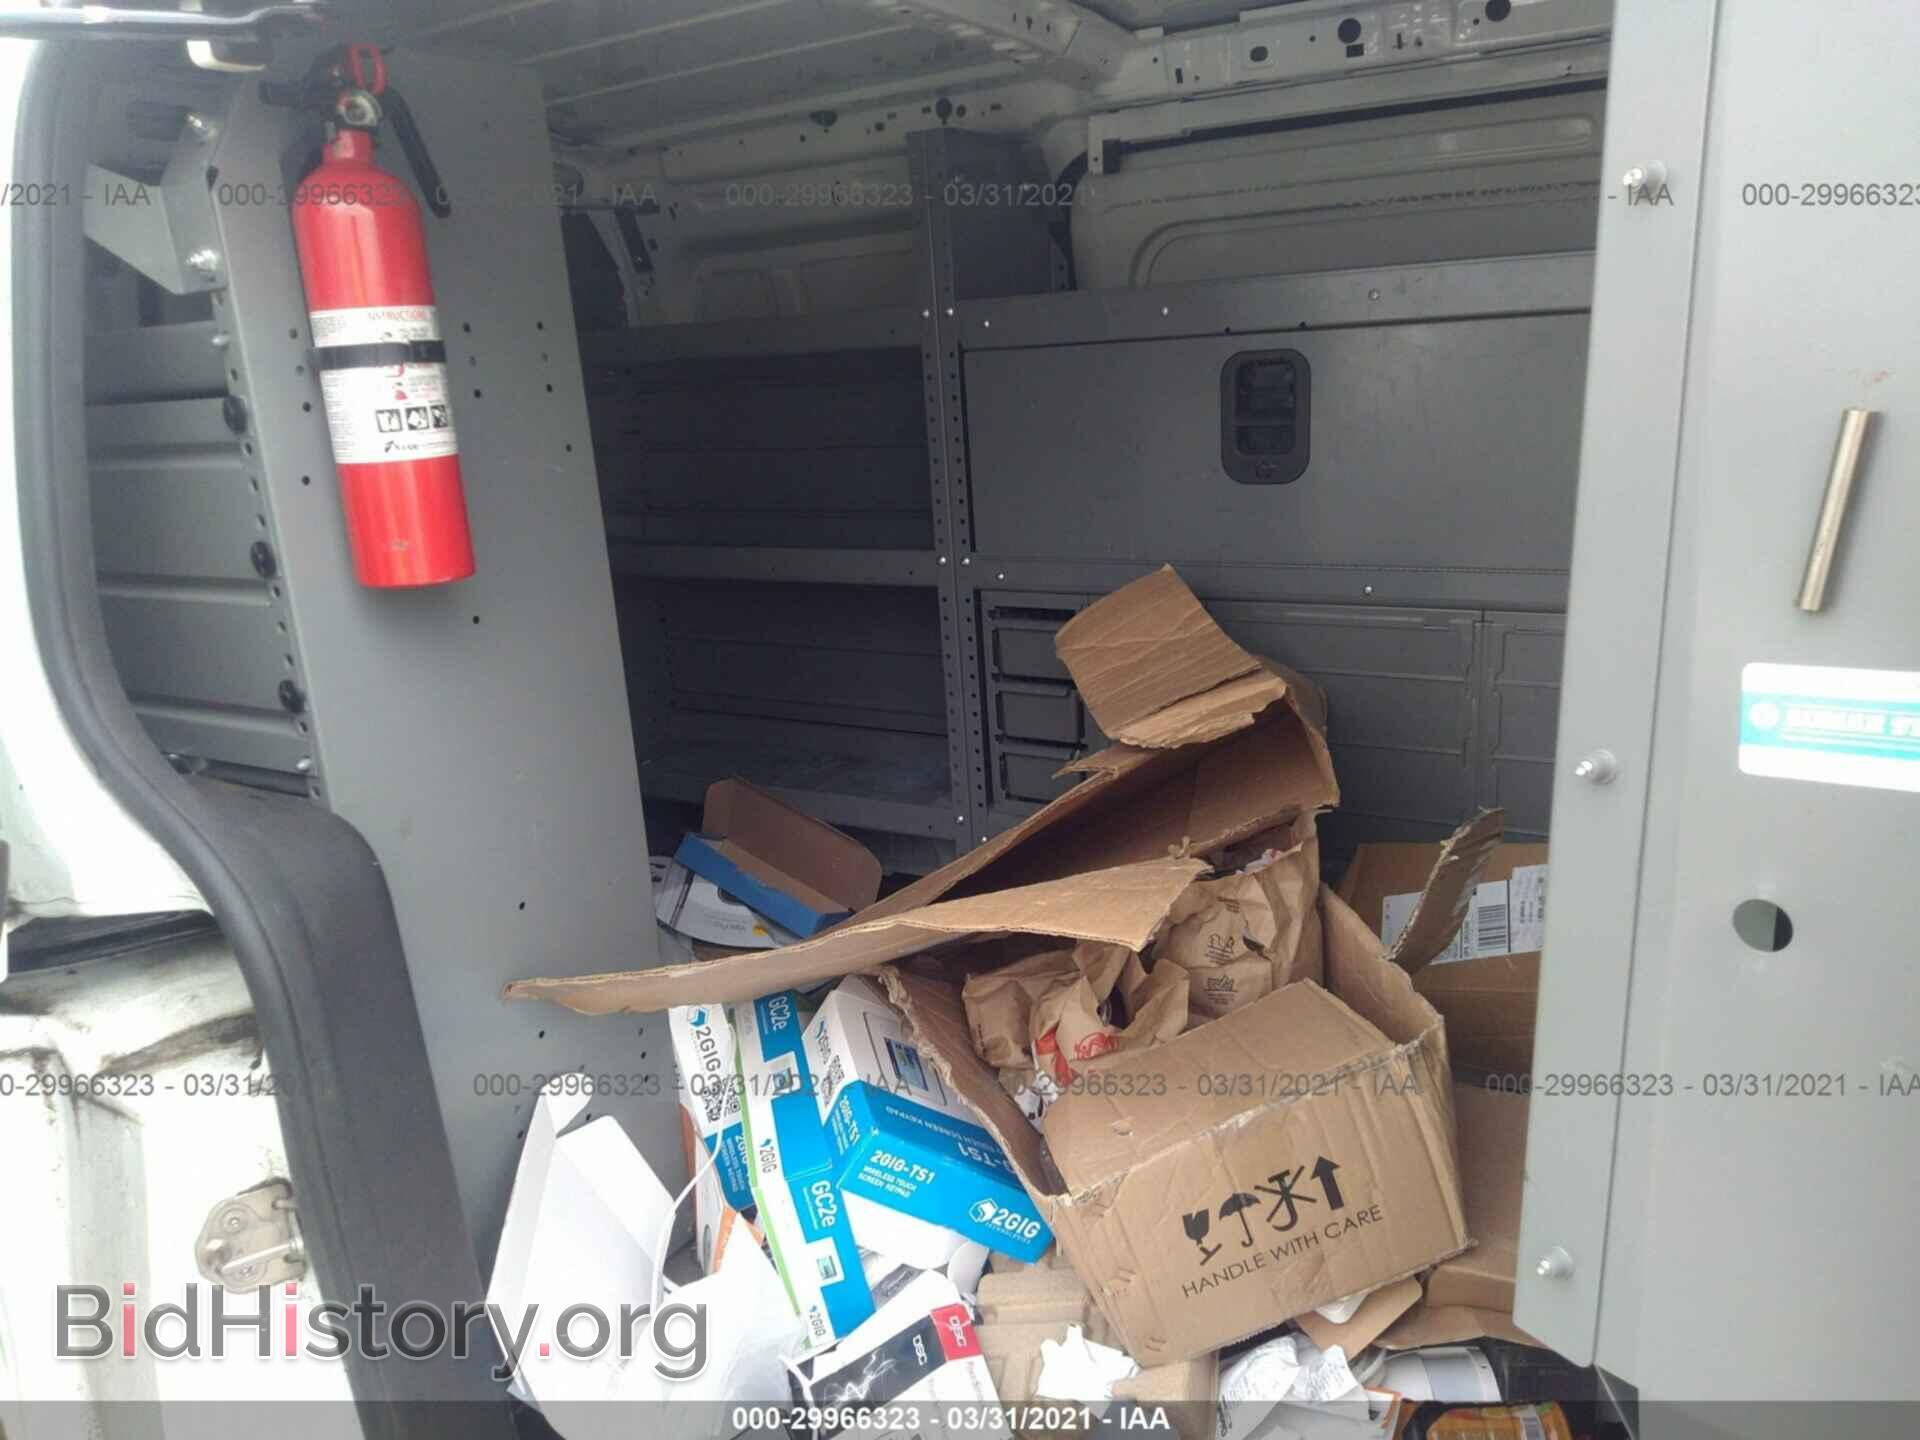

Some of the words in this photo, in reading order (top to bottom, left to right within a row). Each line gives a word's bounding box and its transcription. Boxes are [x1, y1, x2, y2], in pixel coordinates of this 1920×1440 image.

[695, 1026, 722, 1073] 2GIG
[759, 1146, 778, 1174] 2GIG
[869, 1149, 936, 1185] 2GIG-TS1
[811, 1180, 839, 1229] GC2e
[991, 1207, 1041, 1239] 2GIG
[1181, 1252, 1267, 1299] HANDLE
[1269, 1231, 1319, 1262] WITH
[1323, 1204, 1385, 1240] CARE
[808, 1311, 827, 1338] 2GIG
[912, 1333, 928, 1367] DSC
